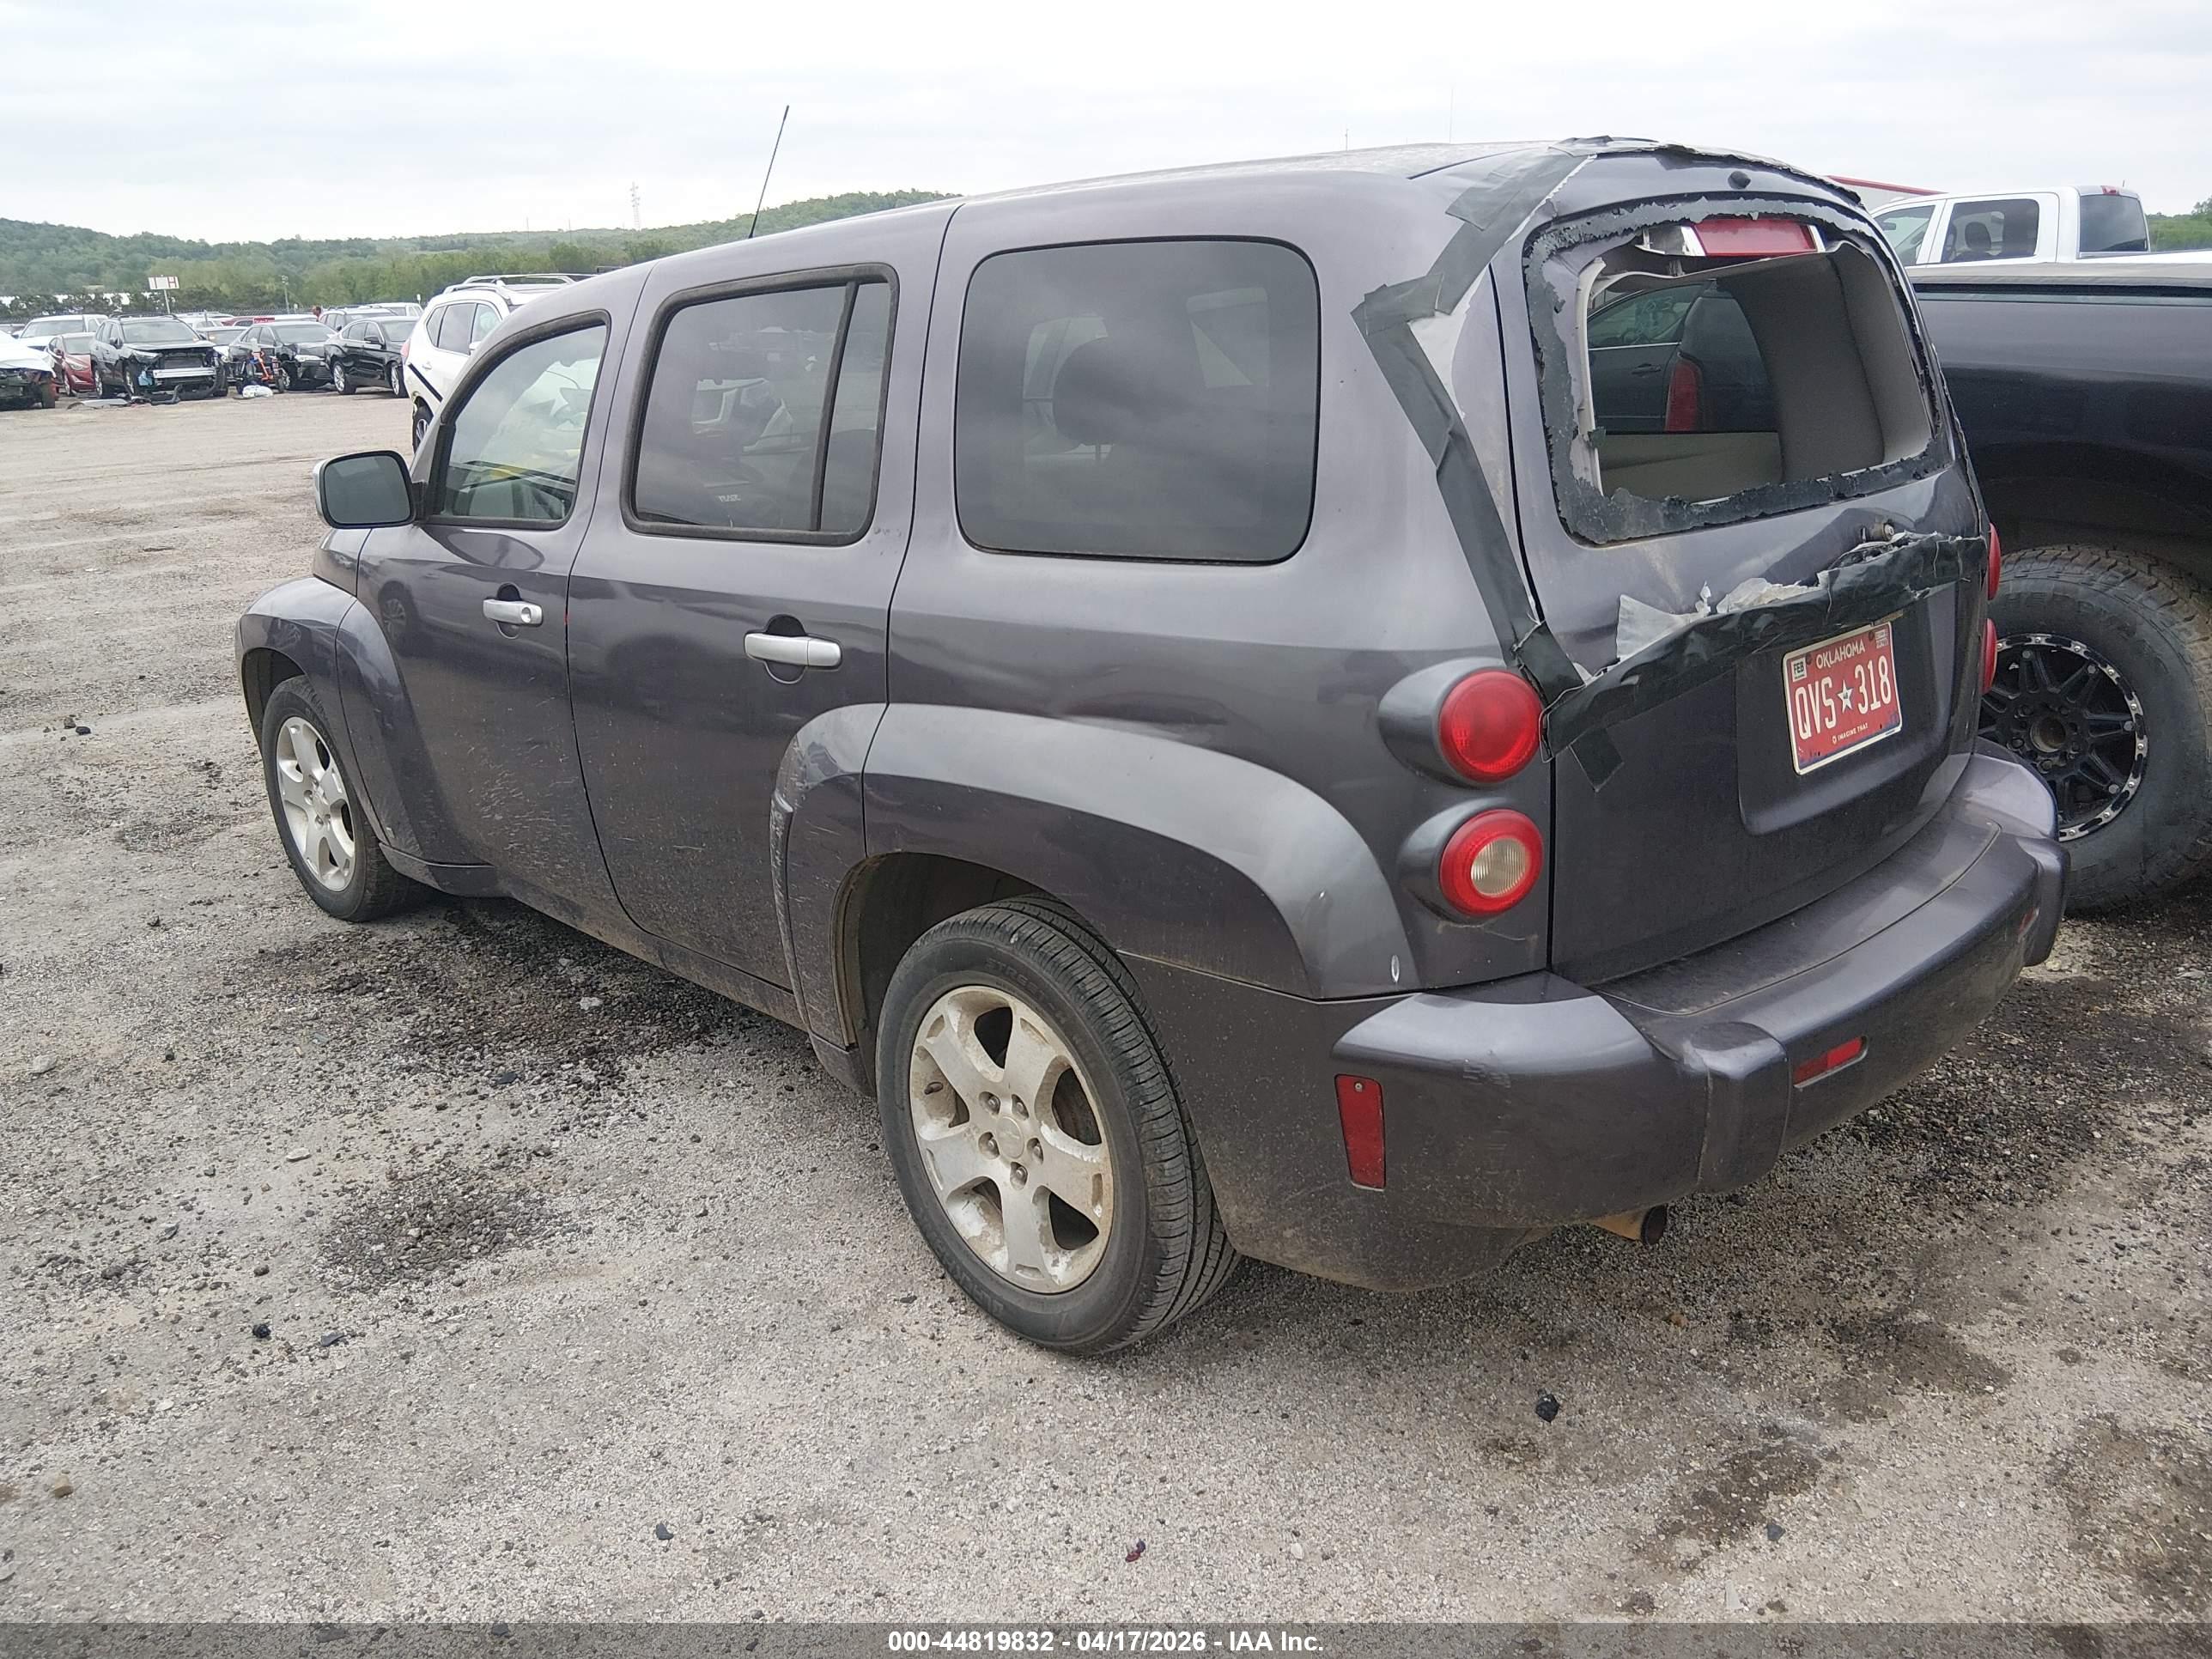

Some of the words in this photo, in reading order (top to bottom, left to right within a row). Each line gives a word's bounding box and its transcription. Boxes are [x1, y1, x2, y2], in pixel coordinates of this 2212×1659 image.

[1815, 639, 1866, 669] OKLAHOMA
[1793, 660, 1805, 675] FEB
[1795, 676, 1837, 740] QVS
[1854, 655, 1892, 714] 318
[1857, 722, 1869, 734] THAT
